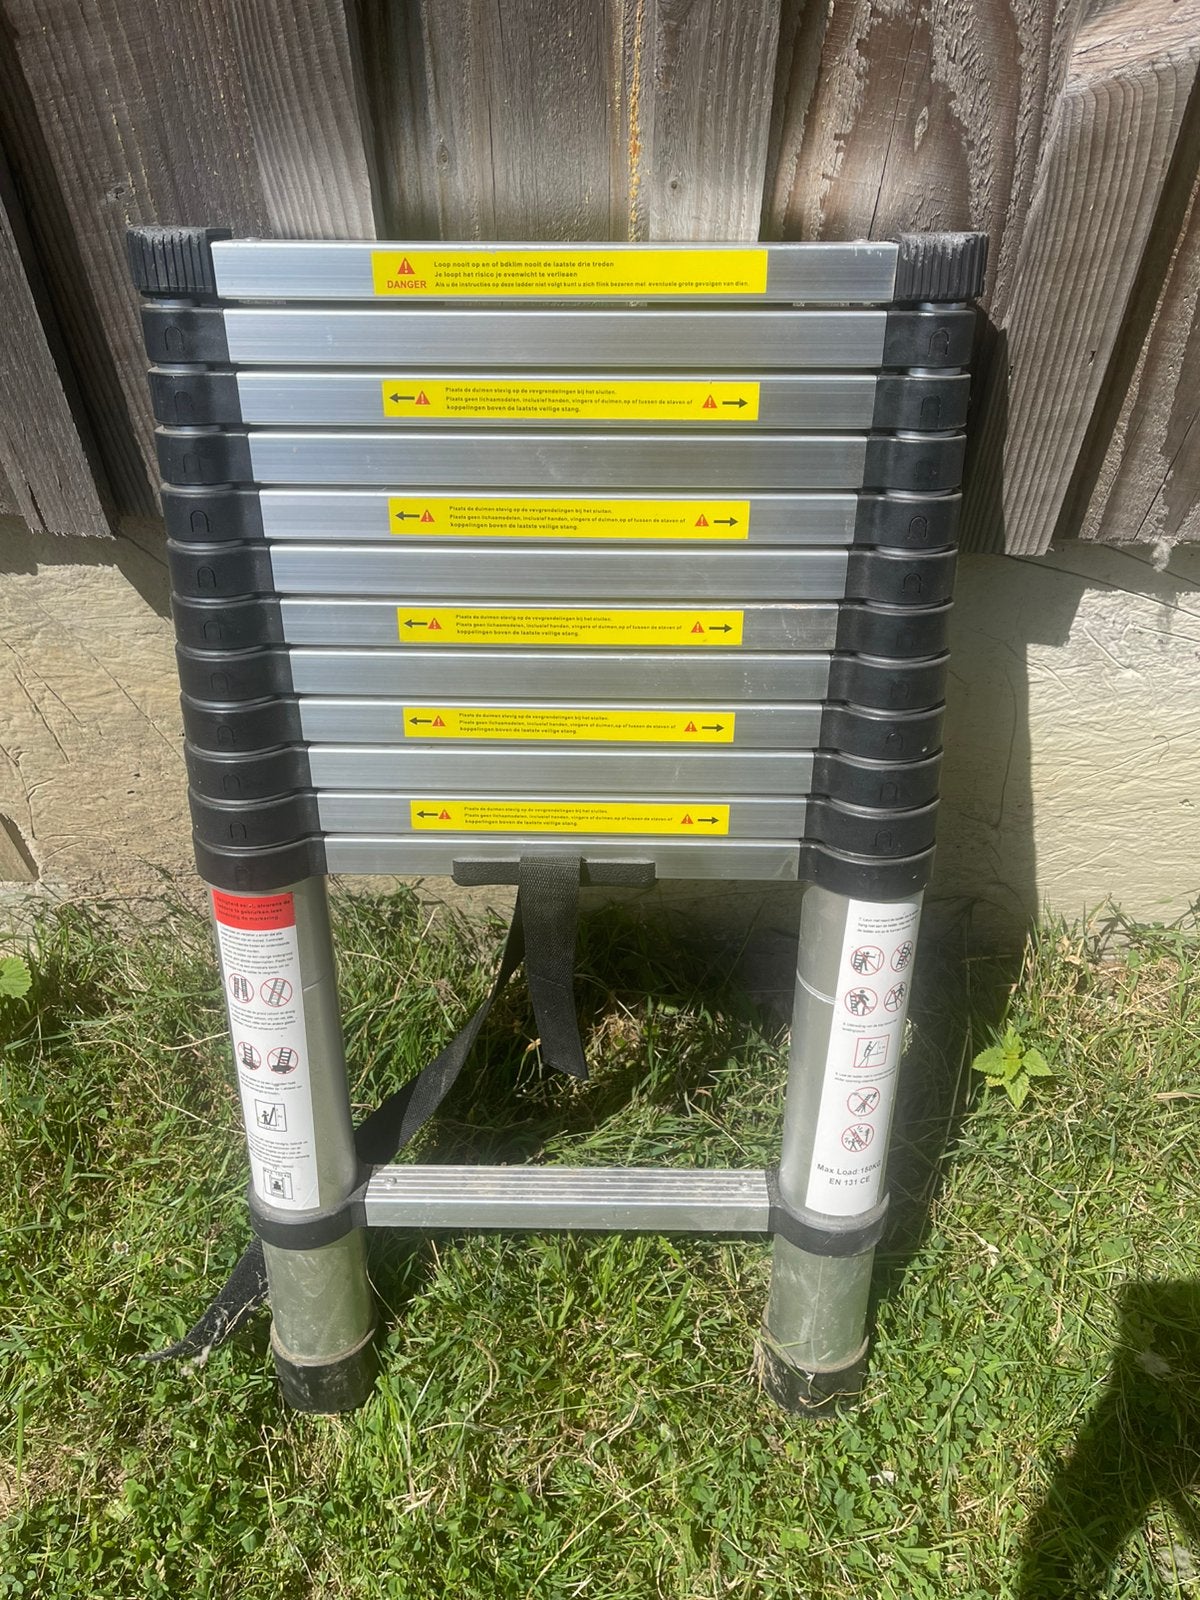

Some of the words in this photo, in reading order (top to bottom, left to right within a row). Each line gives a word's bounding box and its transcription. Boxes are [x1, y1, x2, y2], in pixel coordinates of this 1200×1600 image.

[387, 280, 426, 289] DANGER
[817, 1163, 834, 1174] Max
[829, 1177, 841, 1186] EN
